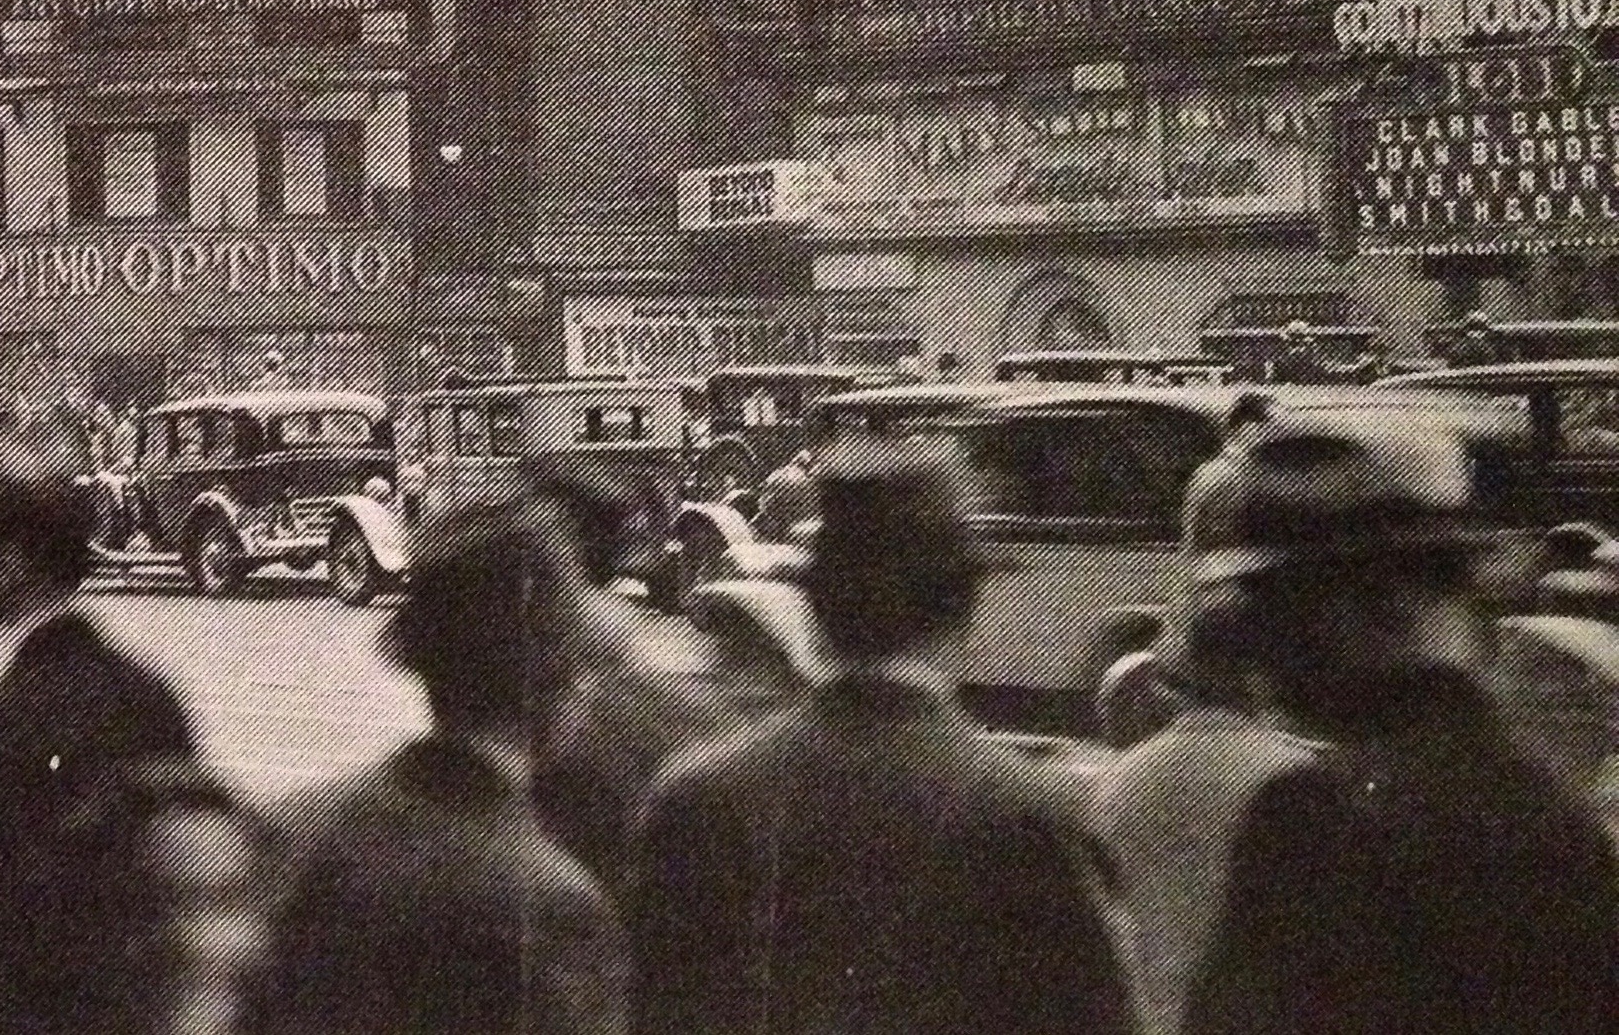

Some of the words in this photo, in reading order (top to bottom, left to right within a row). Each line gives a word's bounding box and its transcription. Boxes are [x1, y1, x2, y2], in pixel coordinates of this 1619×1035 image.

[1376, 113, 1490, 145] CLARK
[1363, 140, 1451, 173] JOAN
[708, 169, 775, 198] BEYOND
[119, 238, 393, 295] OPTIMO
